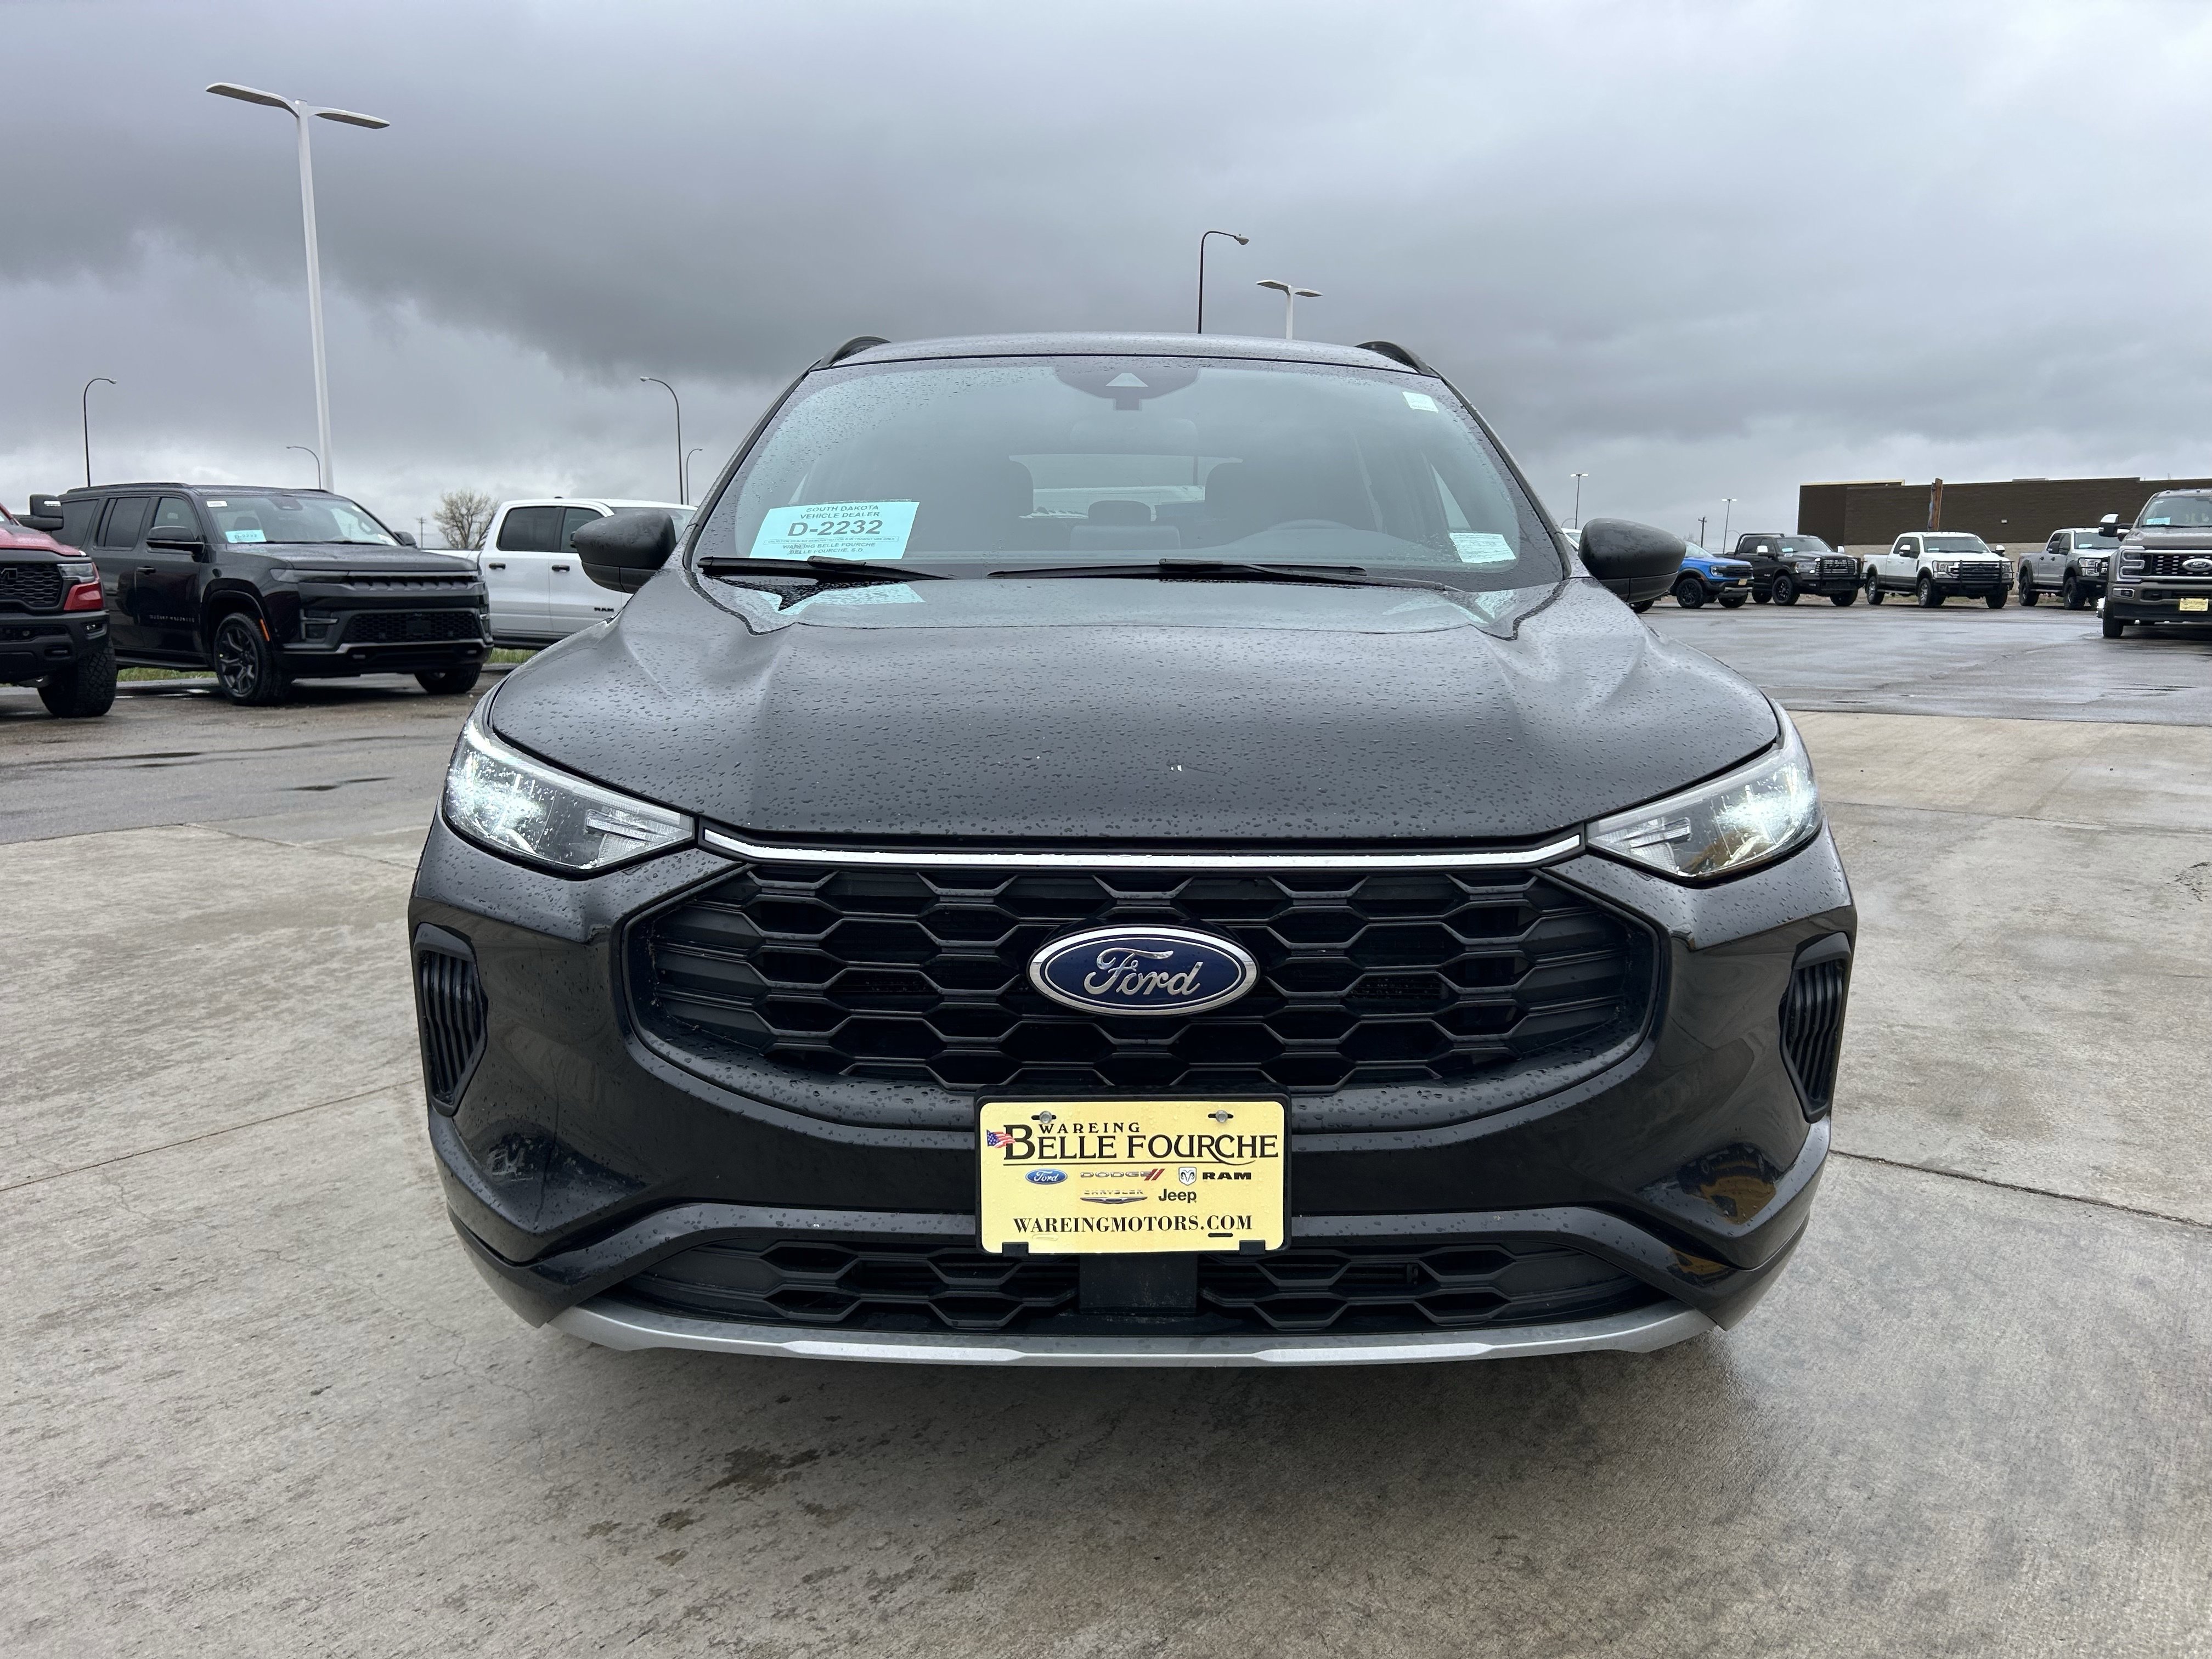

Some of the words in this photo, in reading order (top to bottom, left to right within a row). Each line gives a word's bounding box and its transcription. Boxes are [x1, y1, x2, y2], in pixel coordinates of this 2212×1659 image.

[787, 520, 883, 537] D-2232
[1084, 947, 1204, 995] Ford
[1039, 1122, 1141, 1134] WAREING
[1003, 1124, 1117, 1160] BELLE
[1127, 1134, 1278, 1165] FOURCHE
[1033, 1170, 1059, 1182] Ford
[1202, 1172, 1251, 1180] RAM
[1158, 1188, 1197, 1204] Jeep
[1013, 1215, 1252, 1233] WAREINGMOTORS.COM
